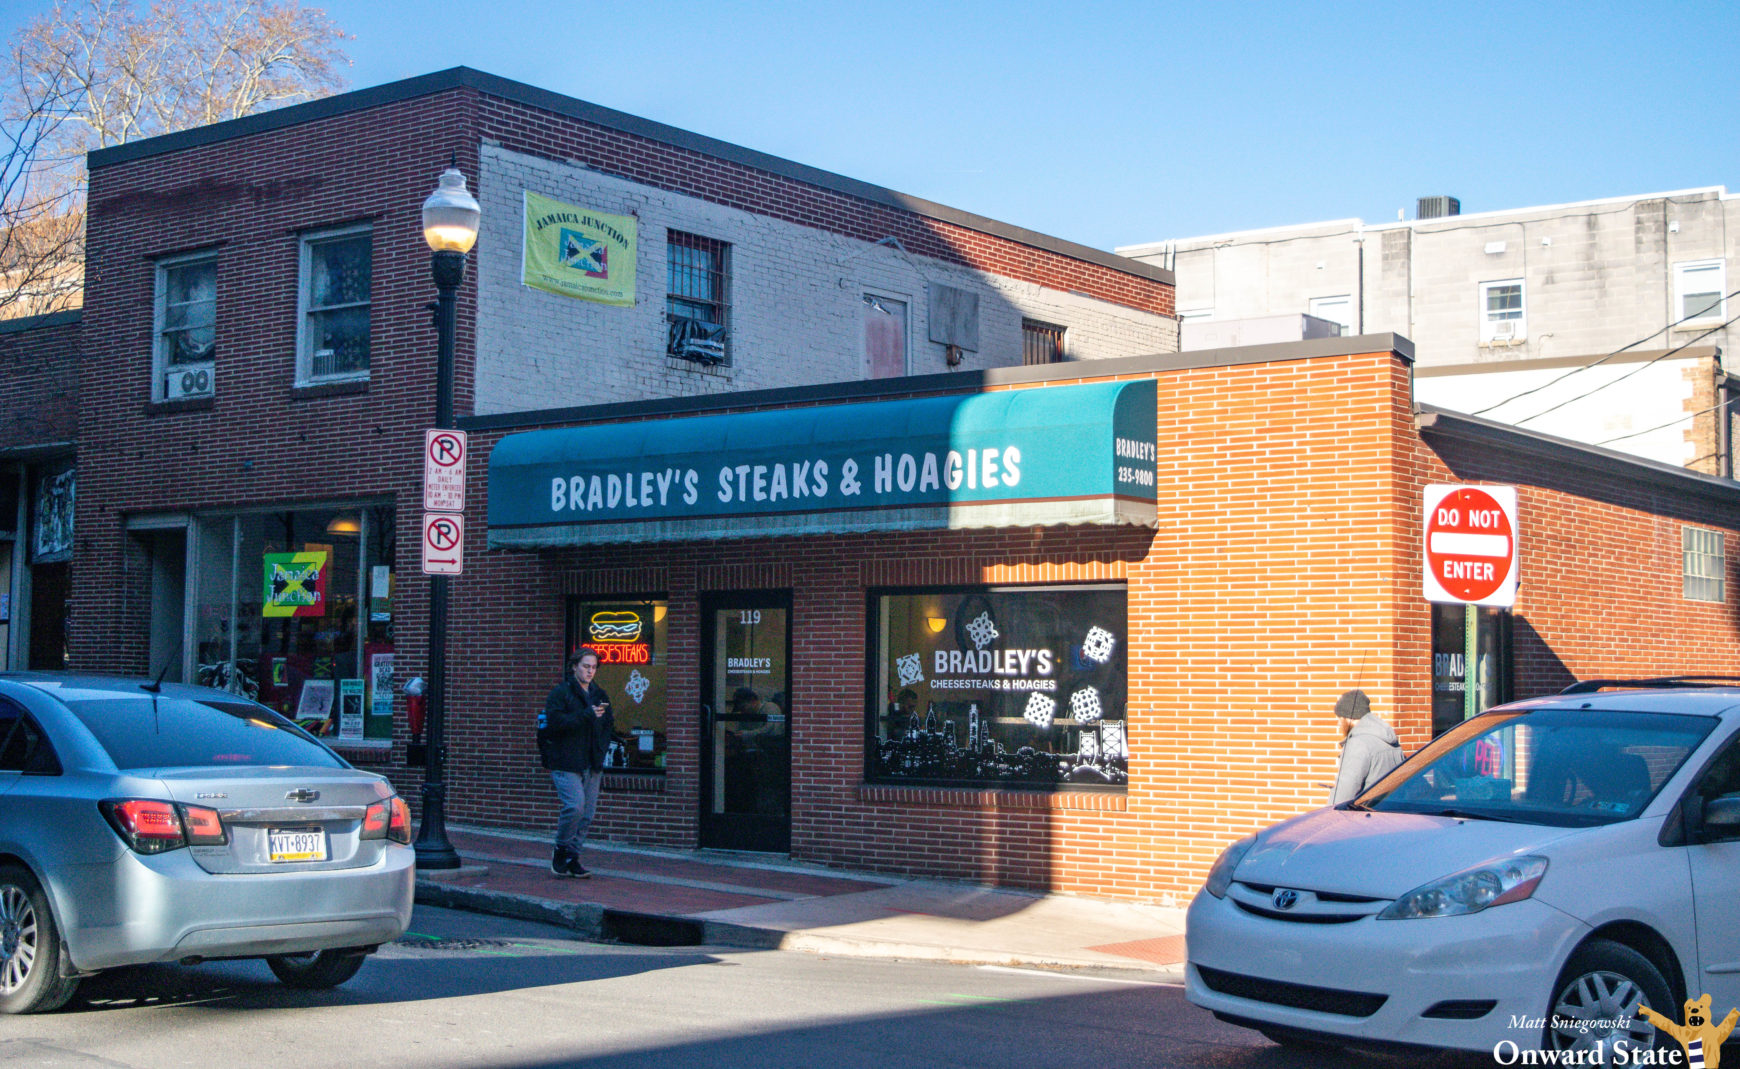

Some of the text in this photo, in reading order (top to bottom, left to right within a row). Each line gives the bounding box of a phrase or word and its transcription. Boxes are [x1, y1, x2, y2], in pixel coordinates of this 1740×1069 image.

[536, 213, 629, 250] JAMAICA JUNCTION
[1116, 437, 1155, 462] BRADLEY'S
[551, 446, 1021, 511] BRADLEY'S STEAKS & HOAGIES
[1118, 466, 1153, 486] 235-9800
[1438, 508, 1501, 528] DO NOT
[269, 563, 320, 582] Jamaica
[1443, 560, 1494, 581] ENTER
[266, 584, 321, 603] Junction
[740, 609, 761, 625] 119
[727, 657, 771, 668] BRADLEY'S
[934, 649, 1053, 675] BRADLEY'S
[930, 679, 1056, 692] CHEESESTEAKS & HOAGIES
